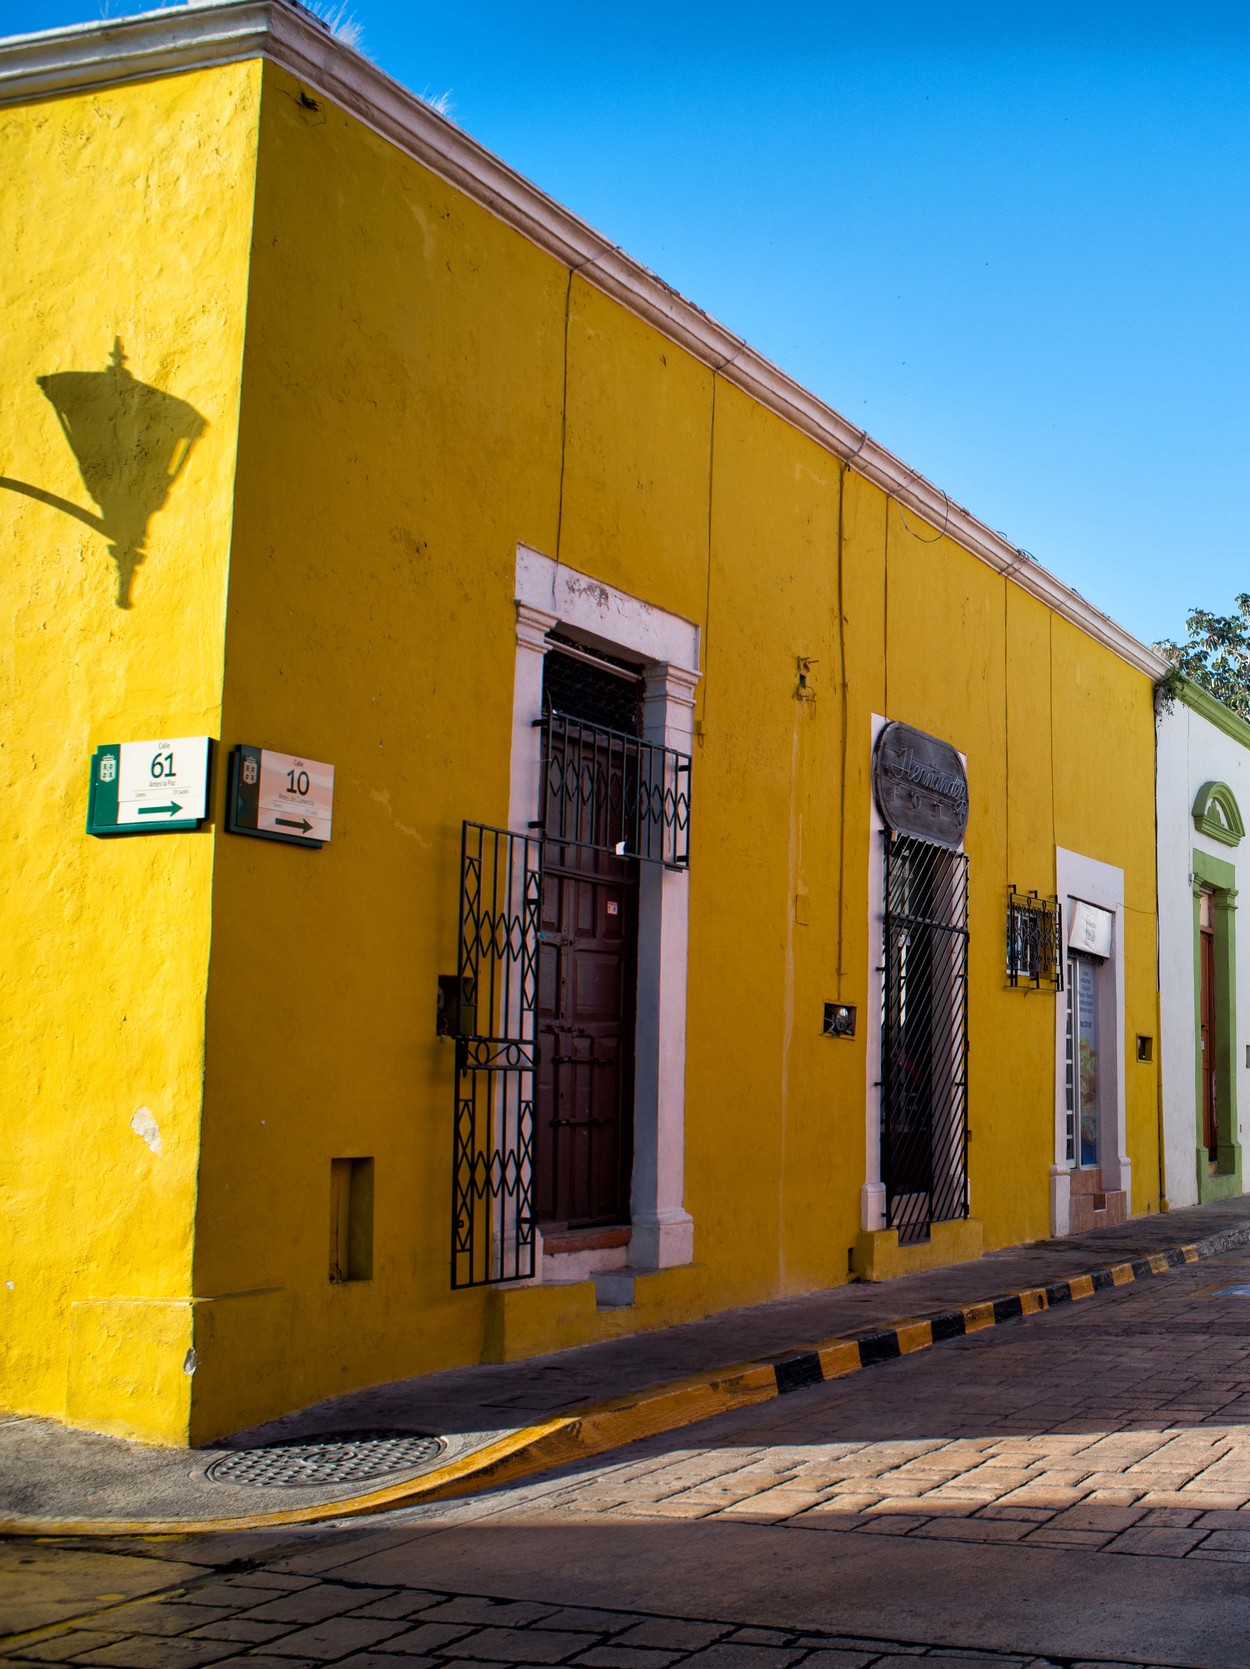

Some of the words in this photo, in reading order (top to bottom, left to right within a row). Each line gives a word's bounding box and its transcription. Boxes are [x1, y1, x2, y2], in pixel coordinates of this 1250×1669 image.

[158, 742, 170, 750] Calle
[151, 752, 176, 779] 61
[293, 759, 304, 768] Calle
[286, 769, 310, 796] 10
[891, 747, 967, 814] Hernandez
